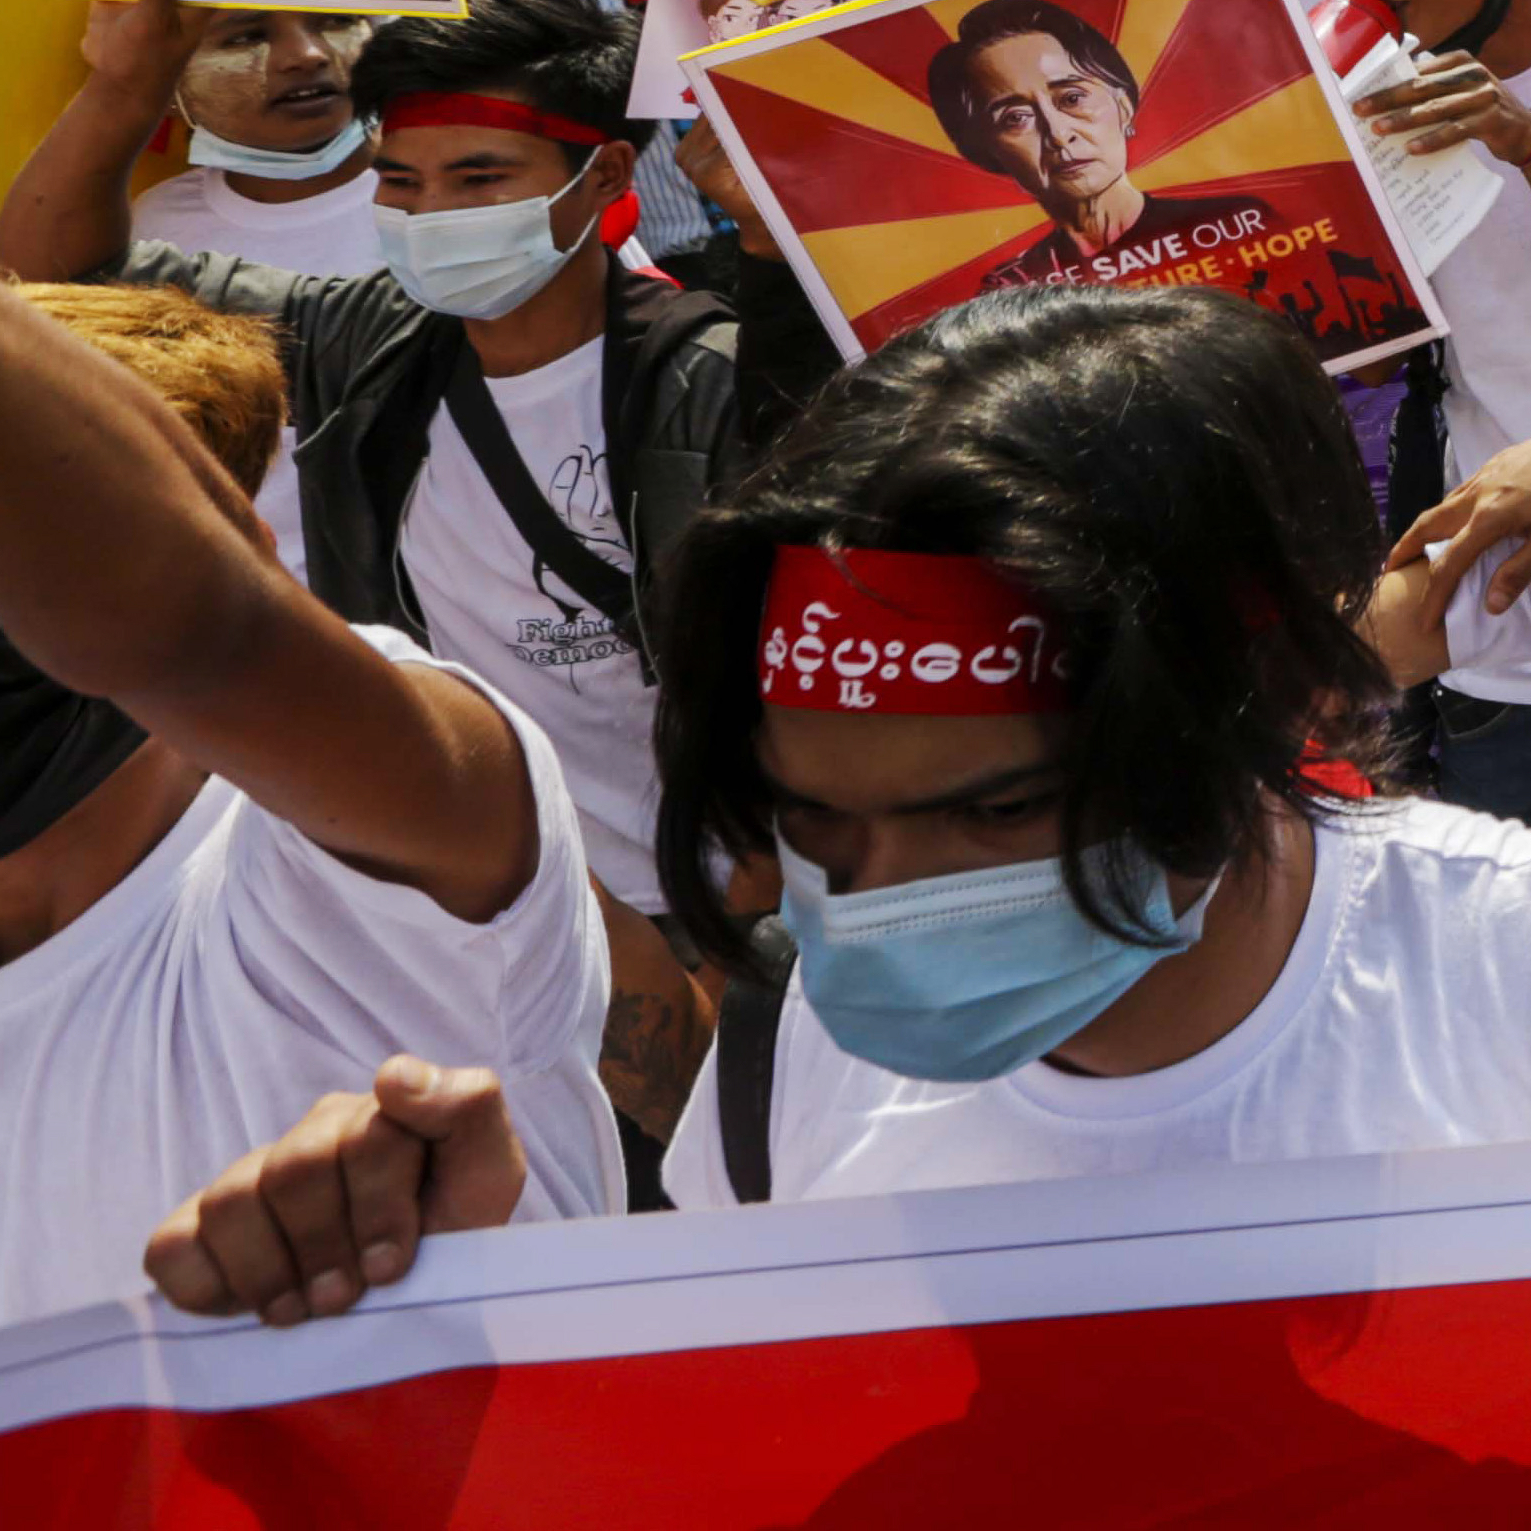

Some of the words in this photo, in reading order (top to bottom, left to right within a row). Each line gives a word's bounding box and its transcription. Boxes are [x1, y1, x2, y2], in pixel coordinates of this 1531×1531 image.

[1091, 233, 1188, 283] SAVE
[1191, 209, 1265, 252] OUR
[1239, 217, 1339, 265] HOPE
